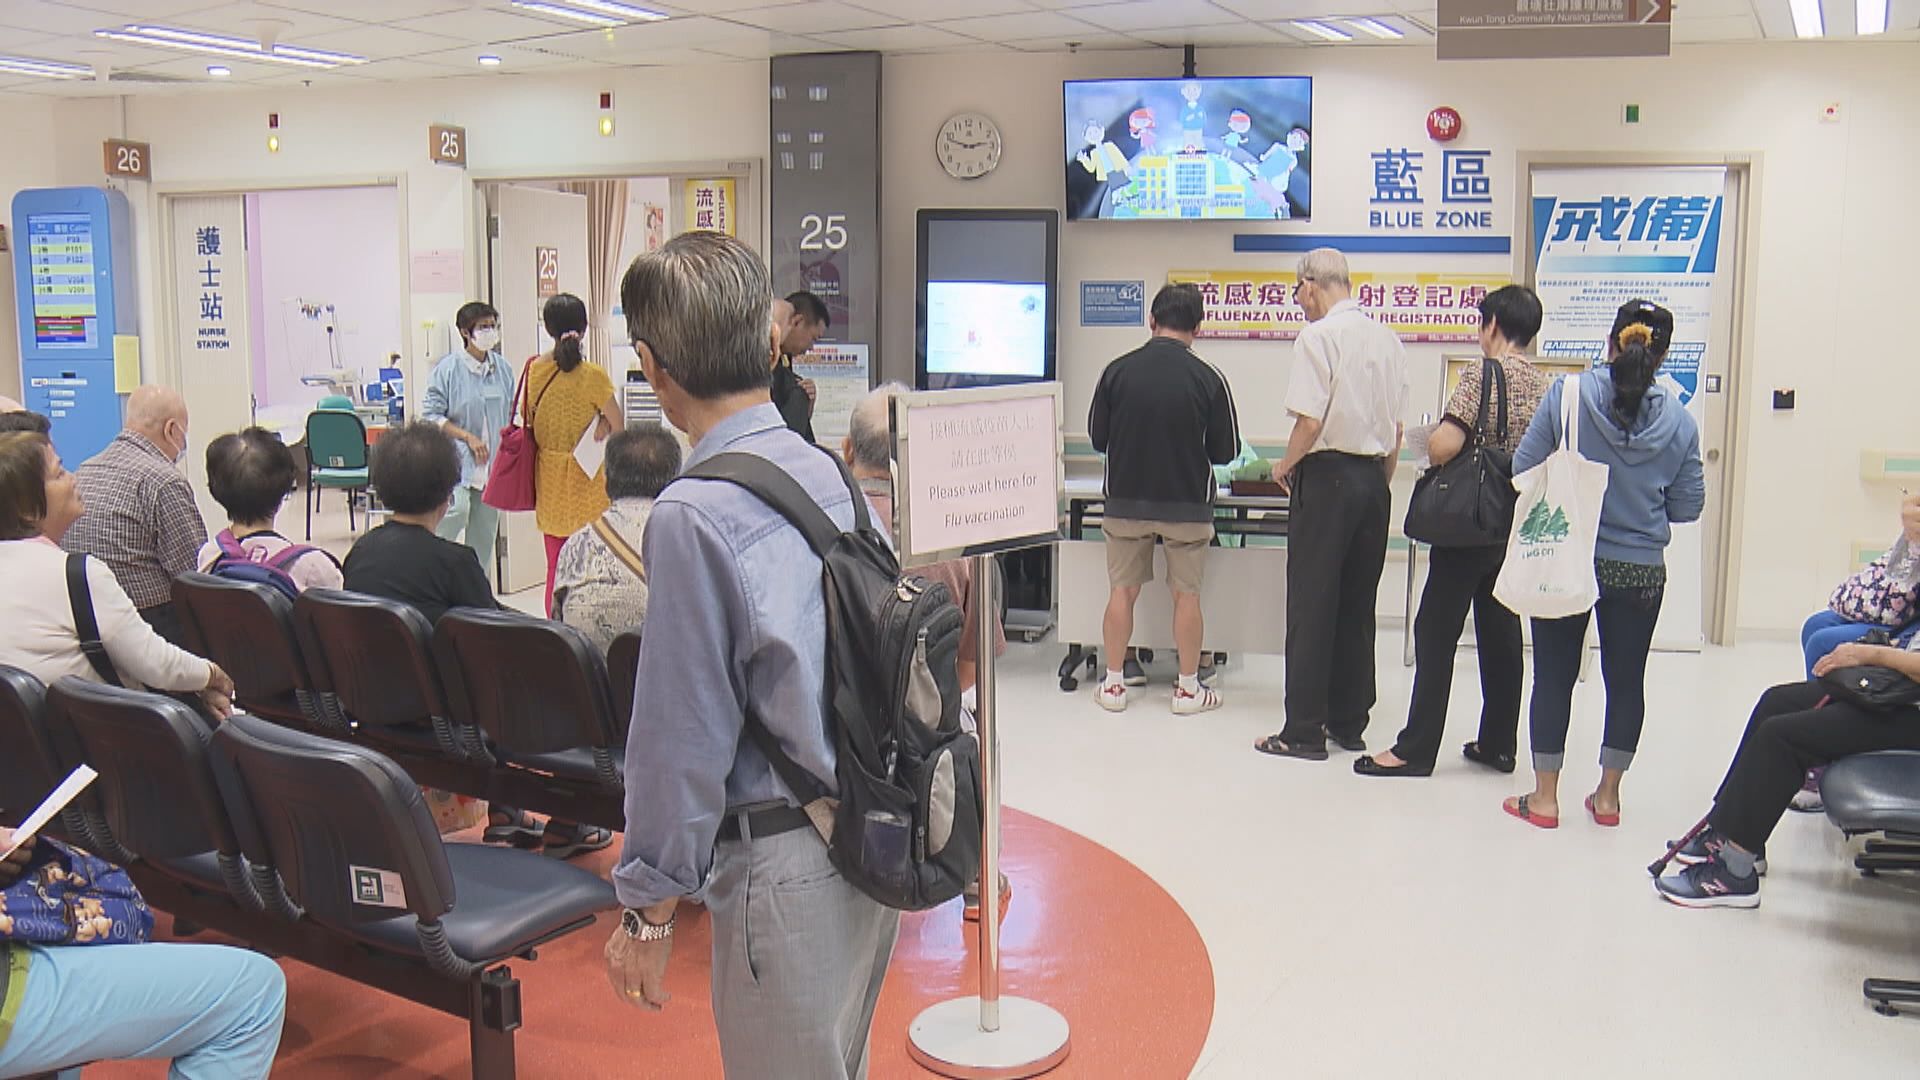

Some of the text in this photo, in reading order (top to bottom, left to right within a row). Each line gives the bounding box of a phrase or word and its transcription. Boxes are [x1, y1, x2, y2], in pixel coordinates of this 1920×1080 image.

[1459, 13, 1624, 25] Kwun Tong Community Nursing Service
[441, 131, 459, 158] 25
[117, 146, 141, 173] 26
[1369, 147, 1493, 203] 藍區
[696, 187, 714, 230] 流感
[1369, 210, 1492, 228] BLUE ZONE
[1551, 195, 1712, 242] 戒備
[800, 214, 848, 250] 25
[196, 225, 223, 322] 護士站
[540, 249, 557, 280] 25
[196, 339, 230, 350] STATION
[198, 328, 227, 337] NURSE
[929, 472, 1038, 501] Please wait here for
[945, 504, 1025, 529] Flu vaccination
